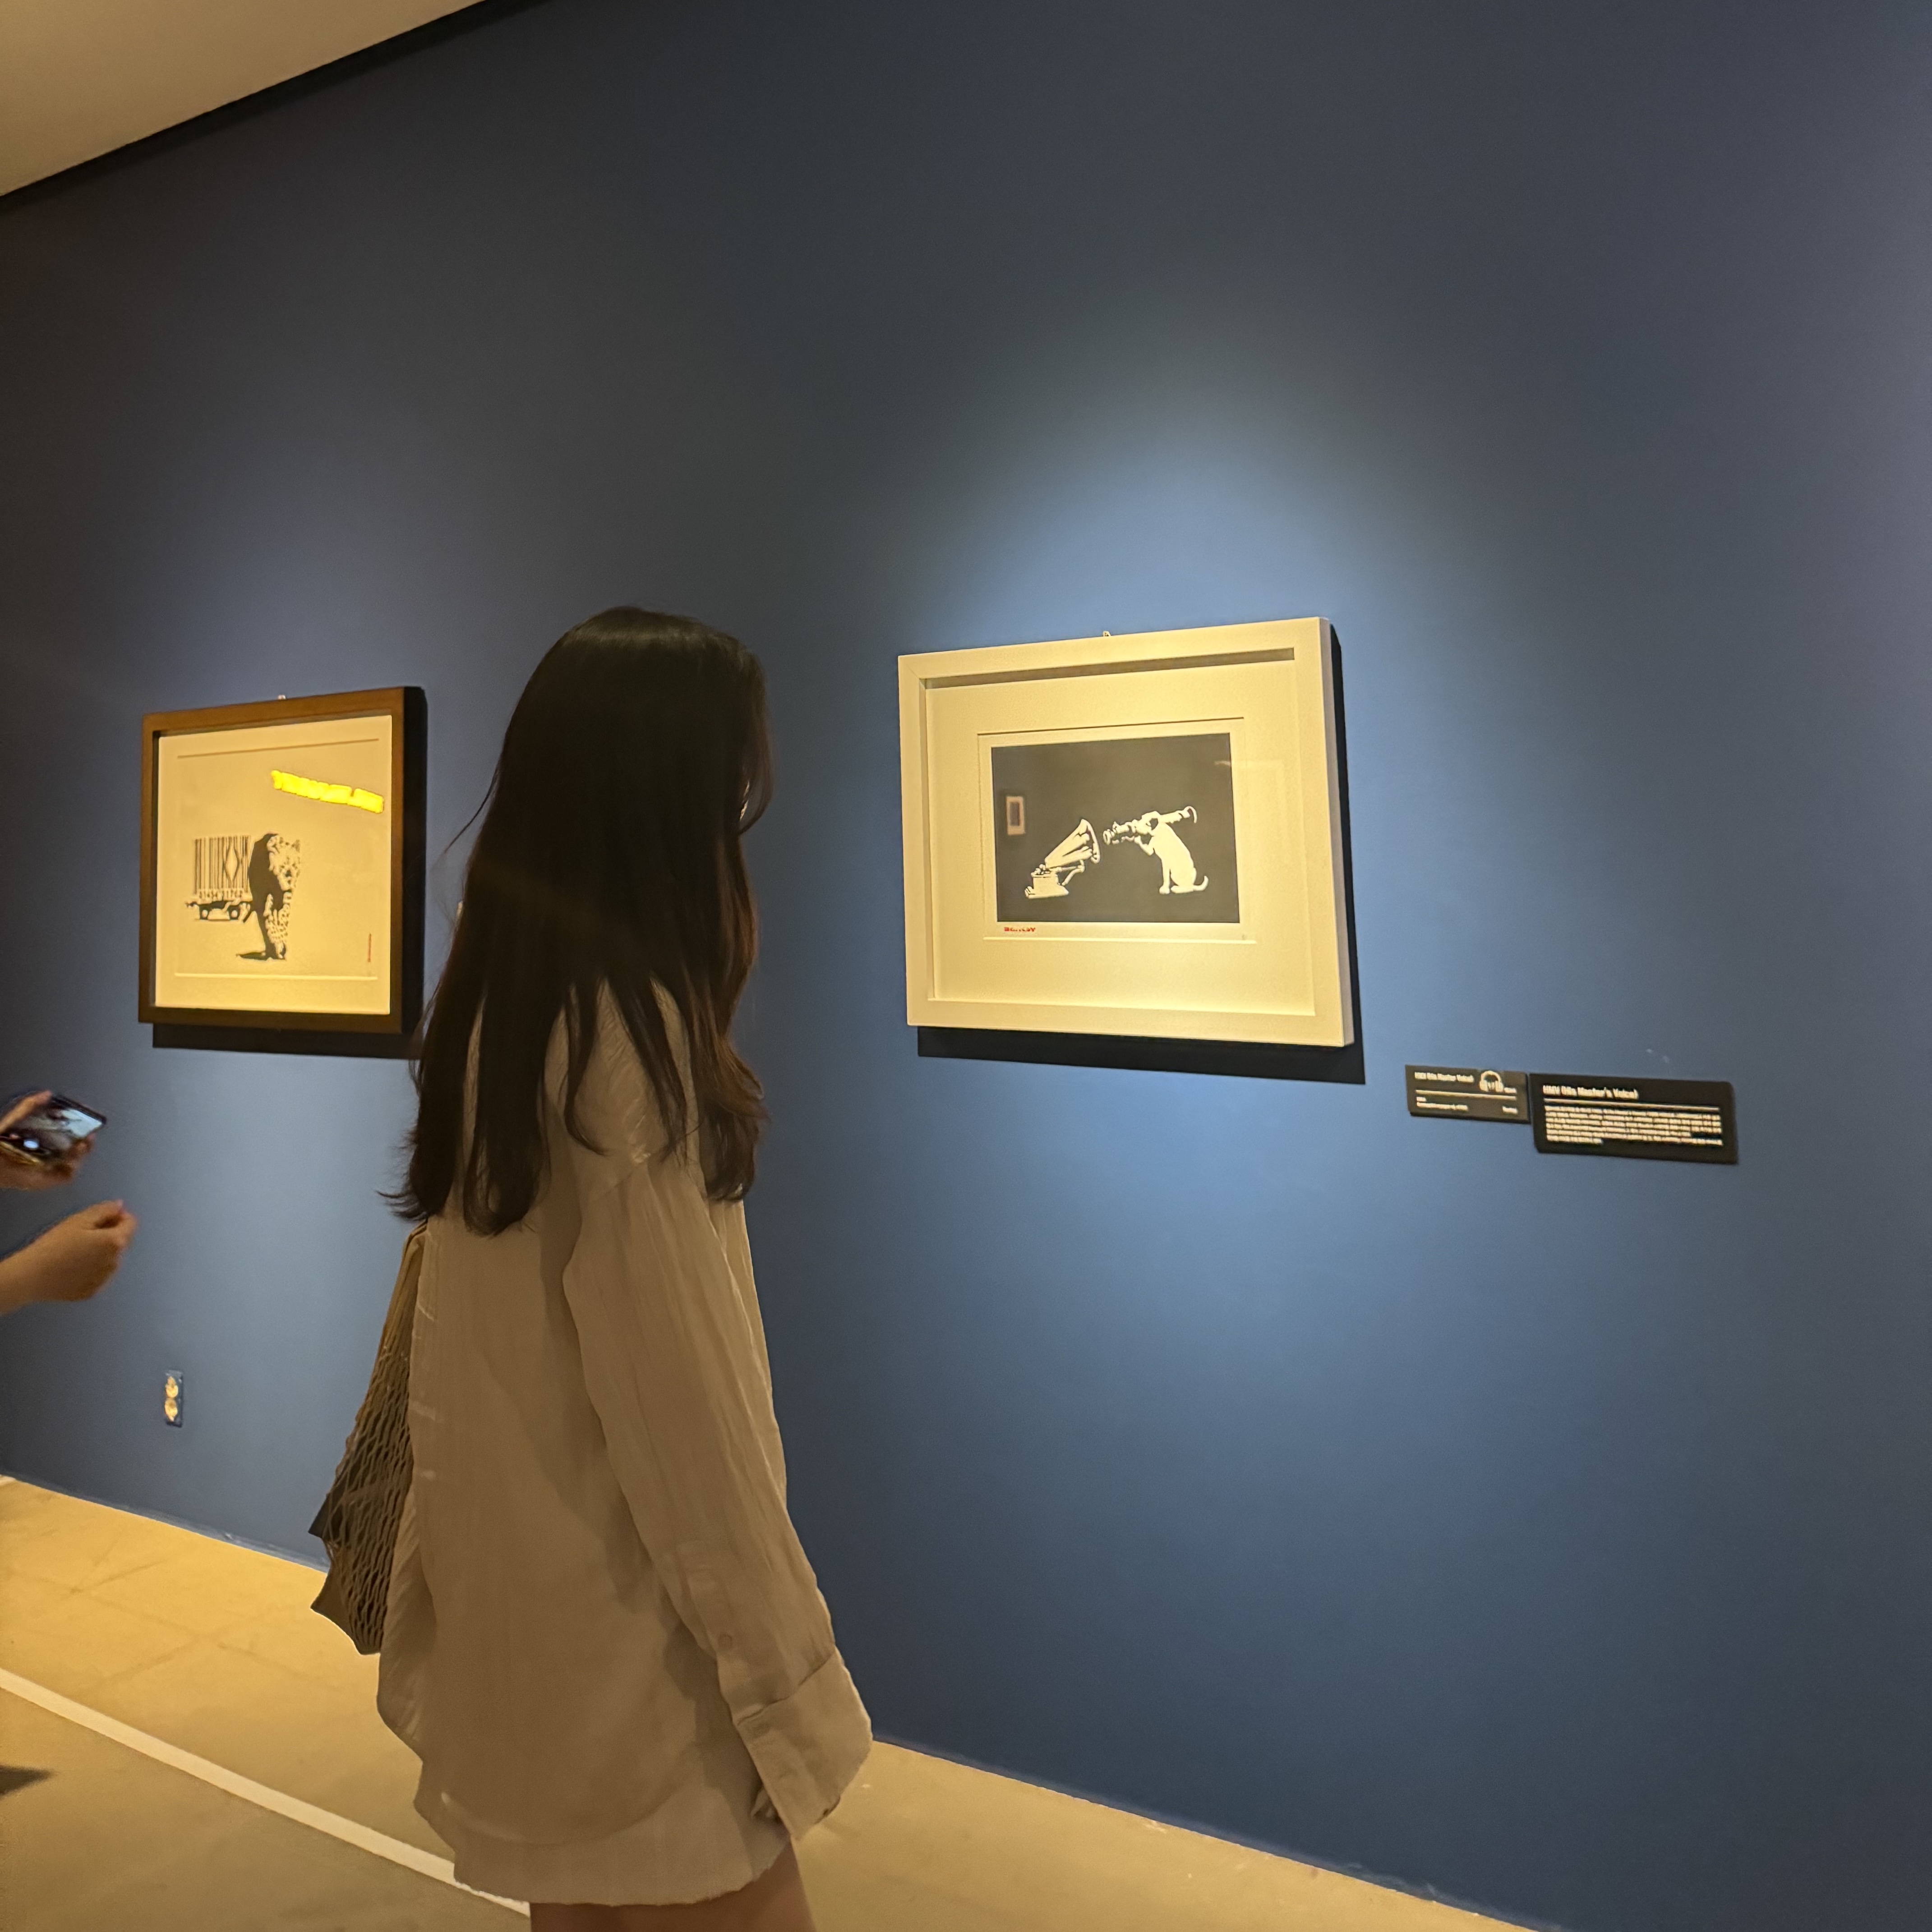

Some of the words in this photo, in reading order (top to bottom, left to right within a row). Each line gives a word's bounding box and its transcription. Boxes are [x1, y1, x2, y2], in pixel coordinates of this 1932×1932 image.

[1543, 1085, 1560, 1095] HMV
[1561, 1086, 1577, 1096] (His
[1577, 1086, 1613, 1098] Master's
[1613, 1087, 1639, 1099] Voice)
